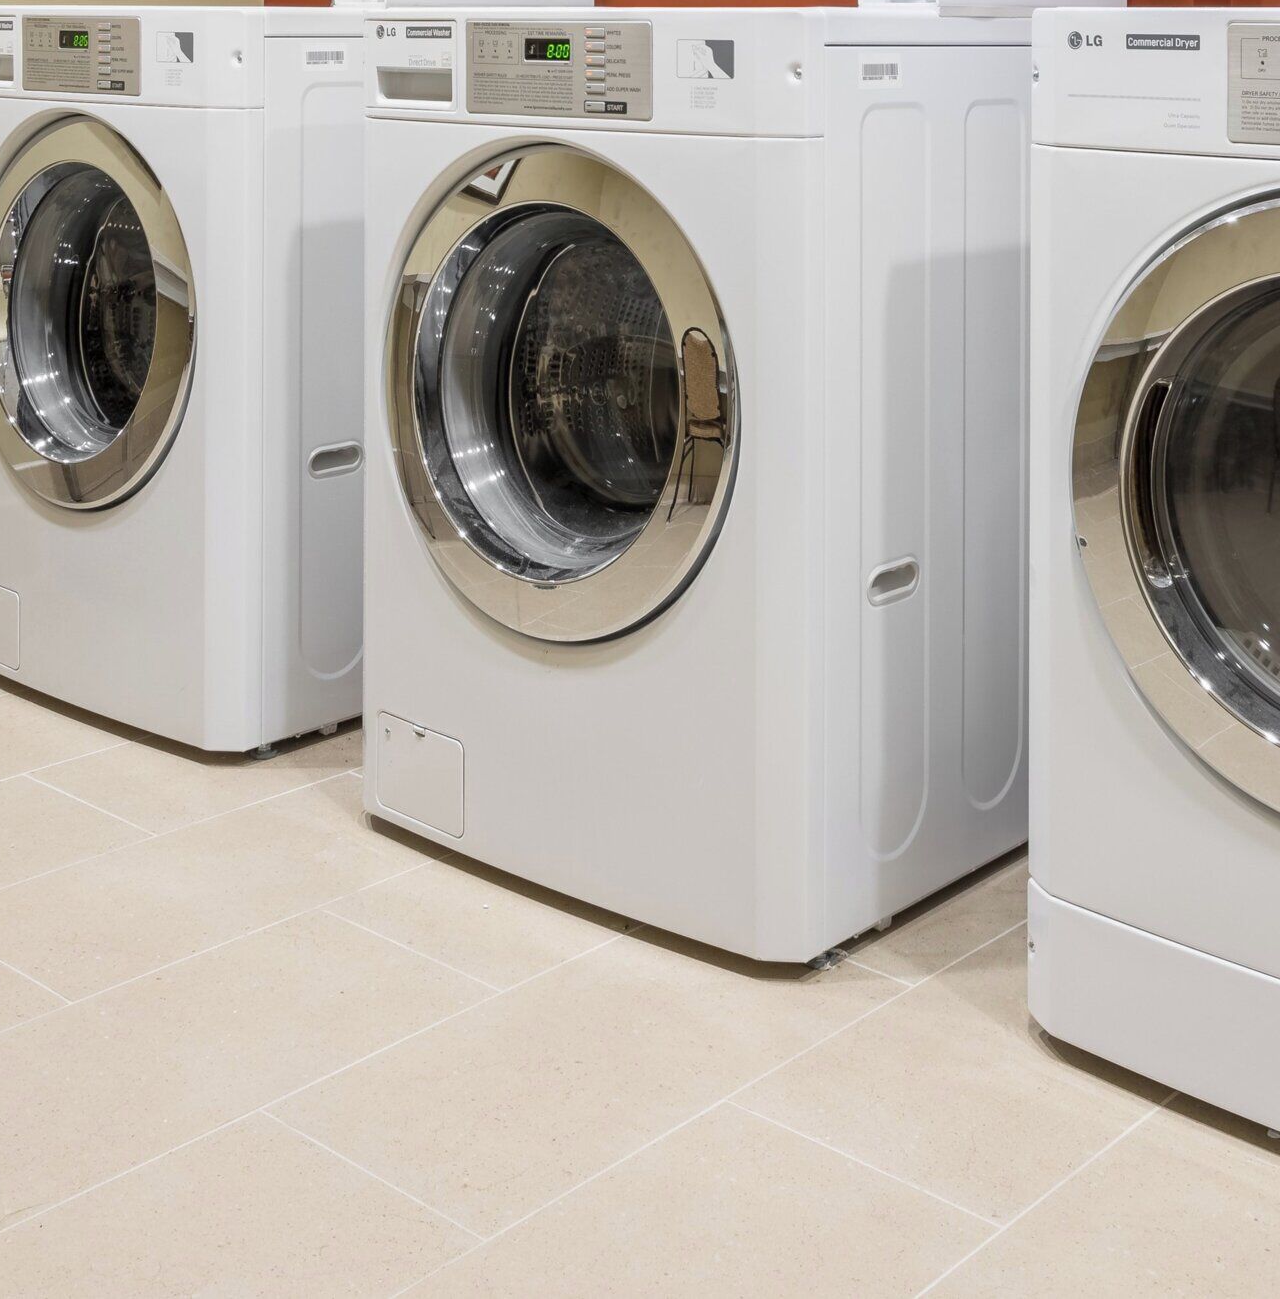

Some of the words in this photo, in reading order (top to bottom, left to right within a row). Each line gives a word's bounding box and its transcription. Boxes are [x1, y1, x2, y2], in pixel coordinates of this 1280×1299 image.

[386, 27, 397, 37] LG
[406, 28, 432, 36] Commercial
[433, 29, 451, 37] Washer
[1086, 35, 1103, 47] LG
[1127, 36, 1174, 48] Commercial
[1175, 37, 1199, 50] Dryer
